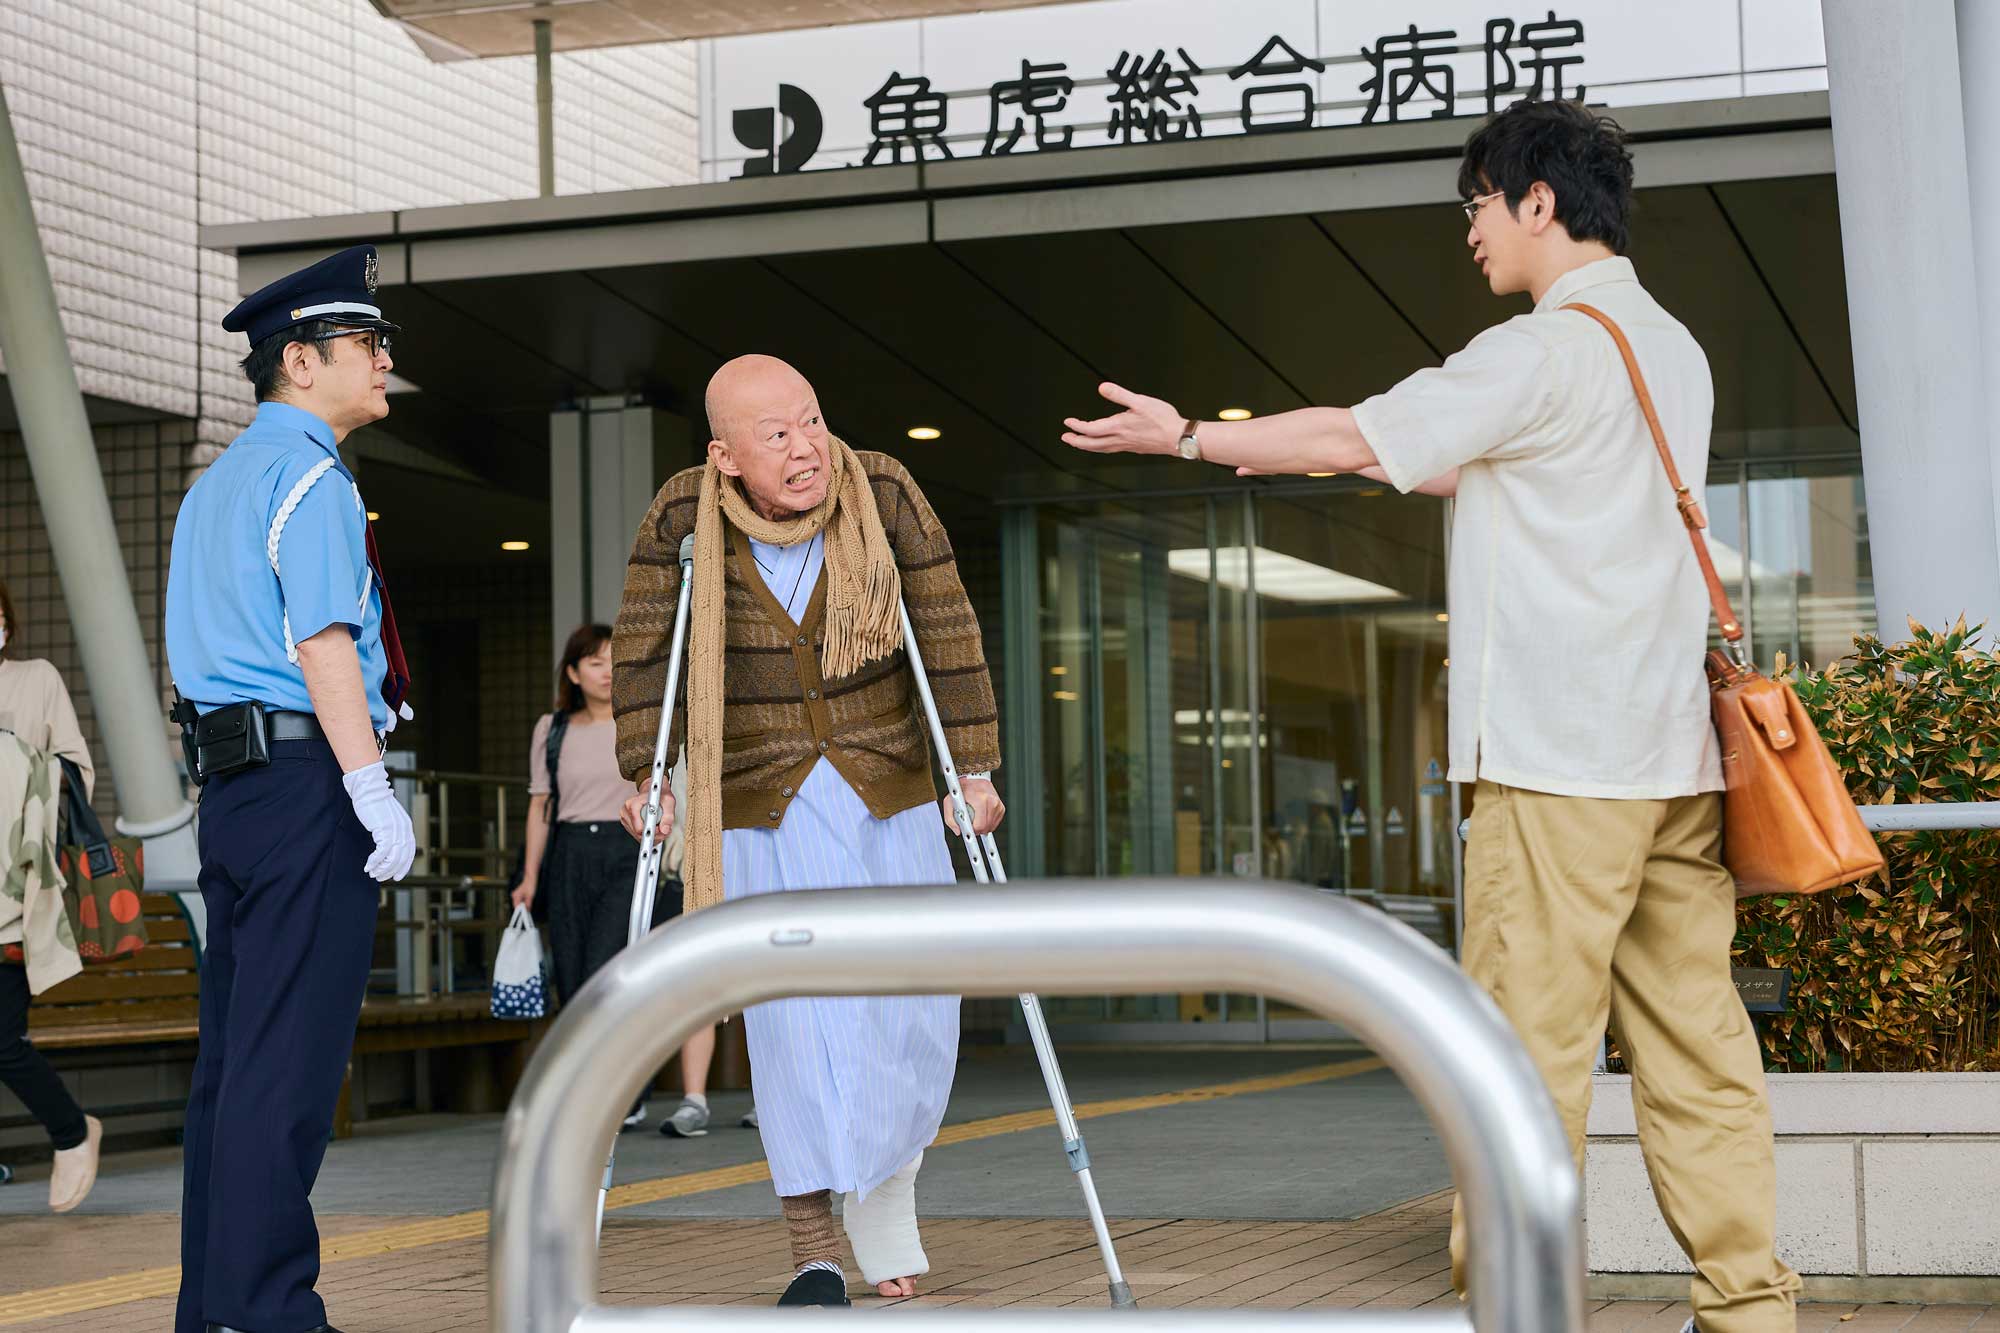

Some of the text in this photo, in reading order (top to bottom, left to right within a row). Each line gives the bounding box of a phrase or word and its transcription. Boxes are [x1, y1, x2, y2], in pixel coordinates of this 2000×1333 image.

[862, 10, 1584, 166] 魚虎総合病院
